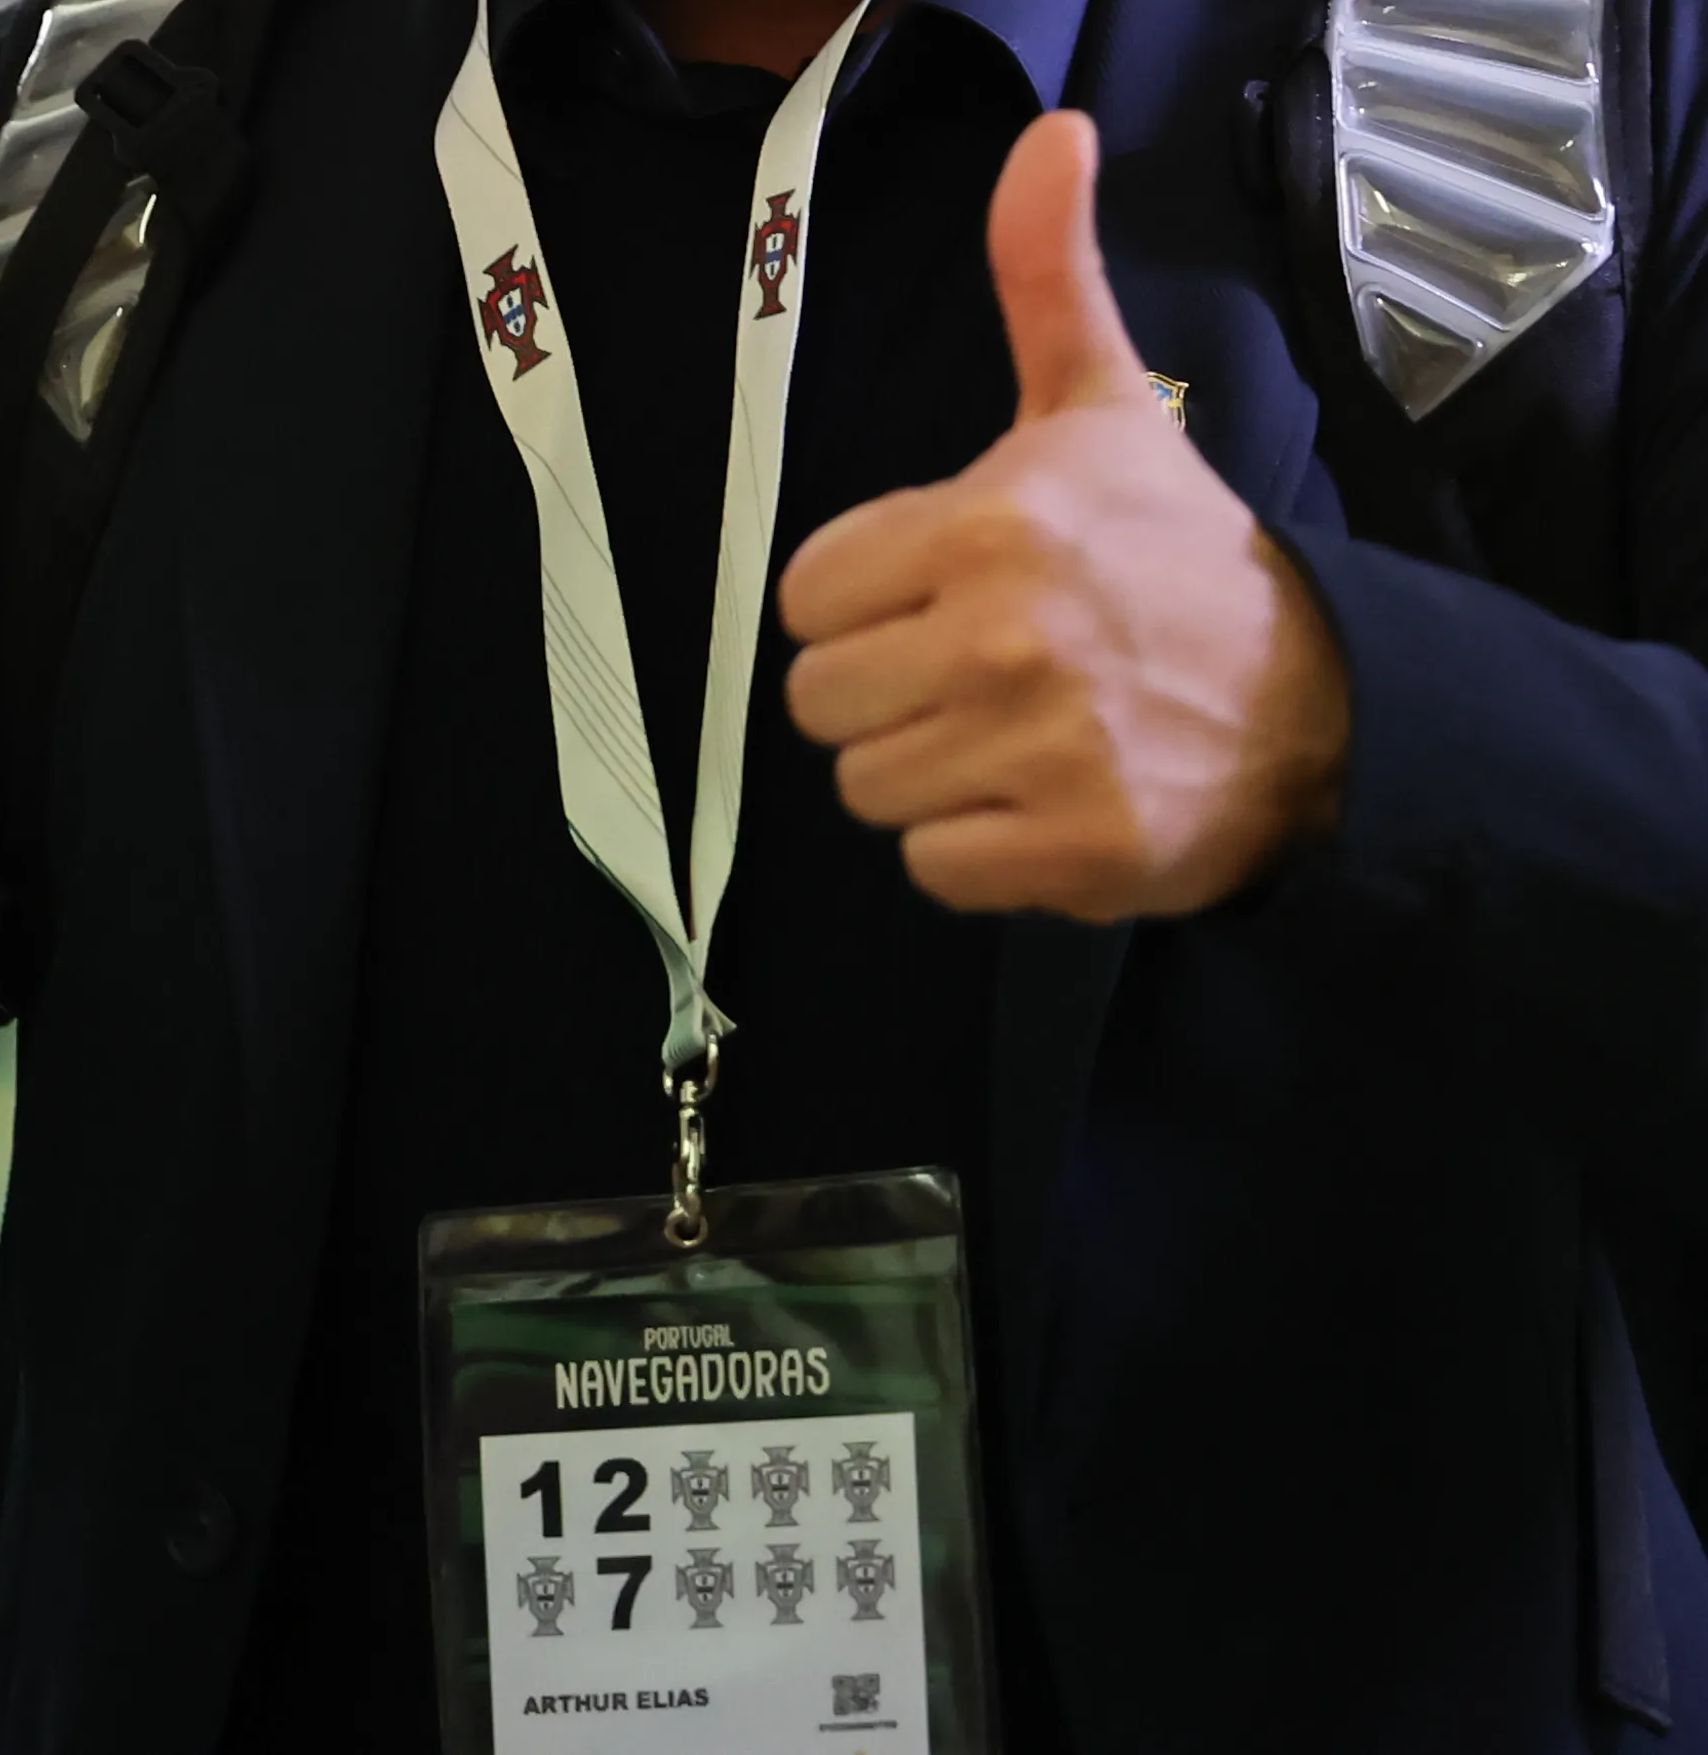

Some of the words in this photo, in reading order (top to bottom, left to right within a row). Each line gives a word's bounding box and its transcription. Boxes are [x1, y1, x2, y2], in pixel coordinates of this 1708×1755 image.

[644, 1324, 735, 1352] PORTUGAL
[554, 1346, 831, 1410] NAVEGADORAS
[595, 1554, 654, 1631] 7
[523, 1692, 629, 1716] ARTHUR
[636, 1687, 710, 1710] ELIAS
